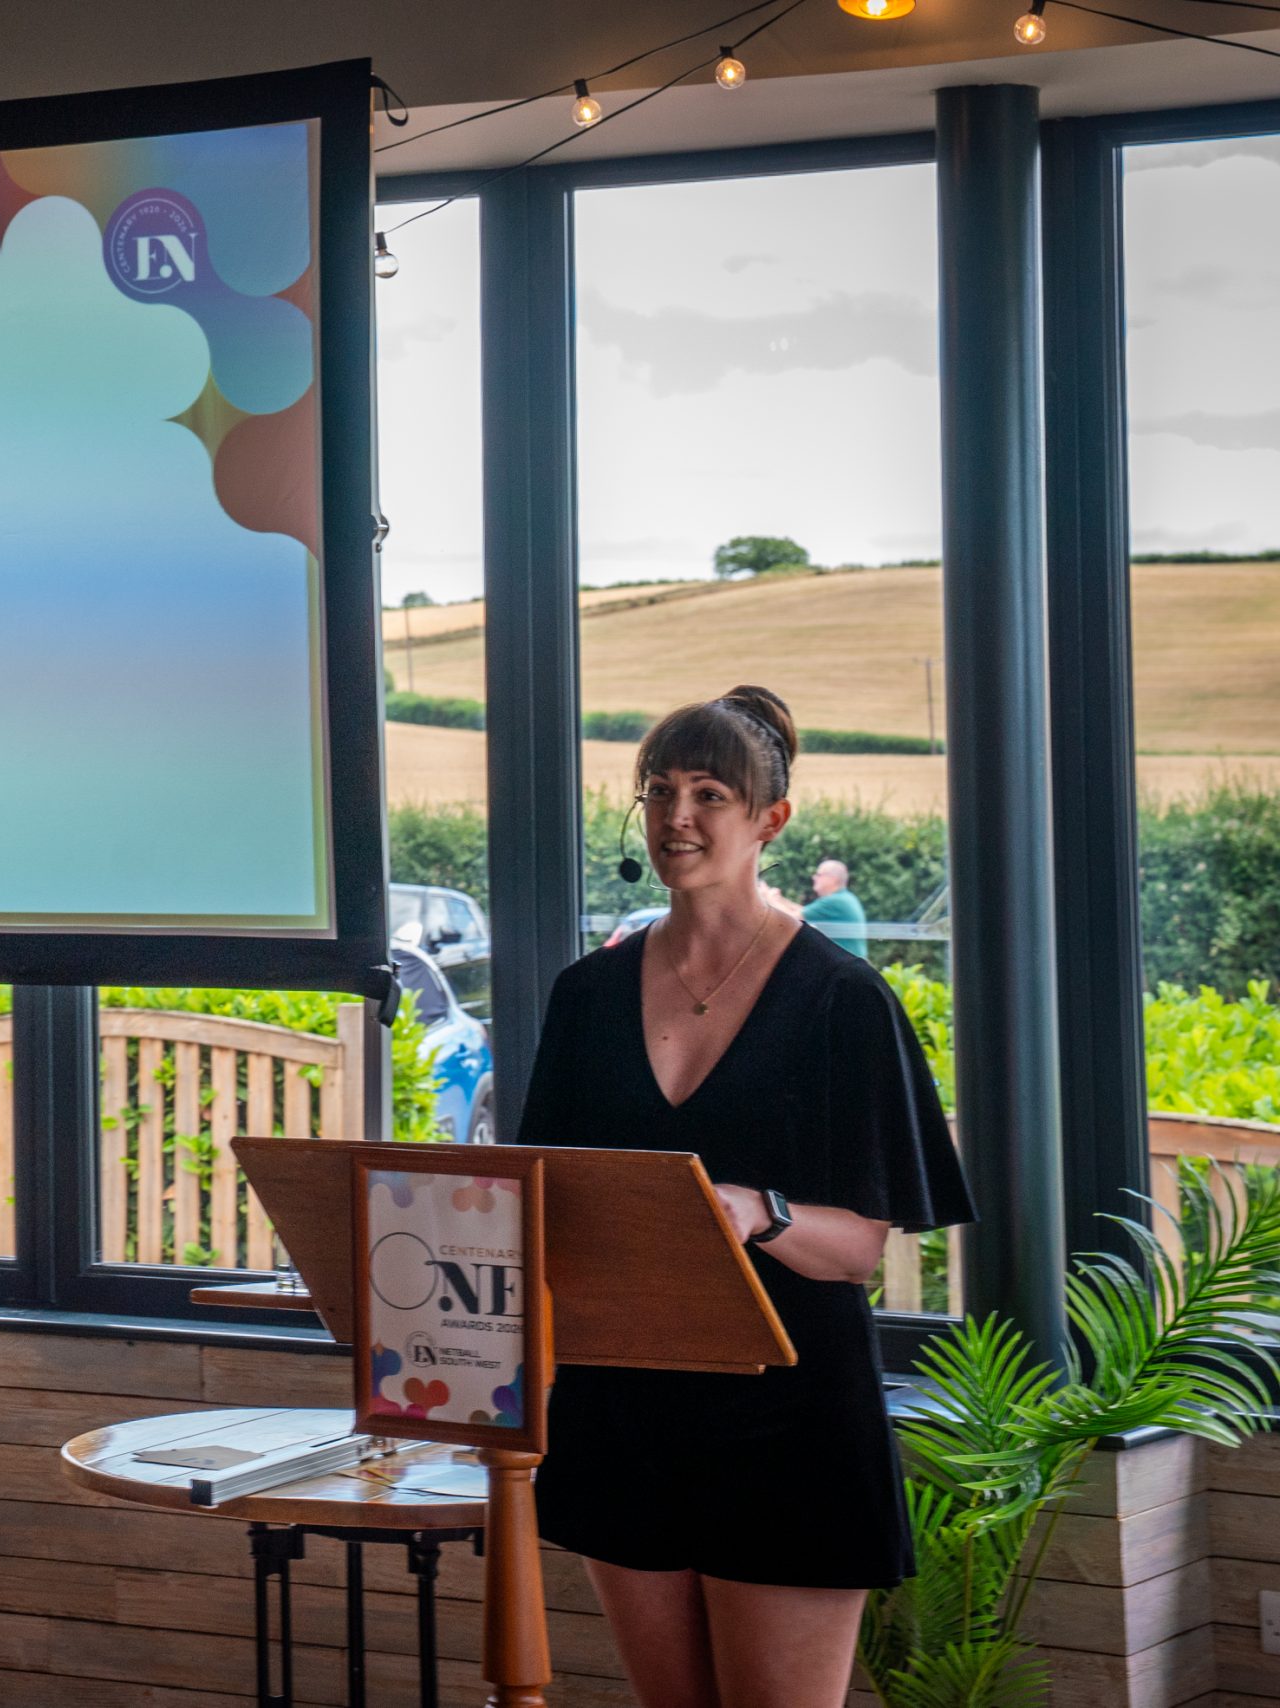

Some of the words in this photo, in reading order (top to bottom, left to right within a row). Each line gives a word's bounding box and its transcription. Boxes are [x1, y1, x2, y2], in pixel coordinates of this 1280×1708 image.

[440, 1319, 494, 1332] AWARDS
[439, 1347, 481, 1358] NETBALL
[439, 1357, 473, 1367] SOUTH
[475, 1360, 502, 1370] WEST
